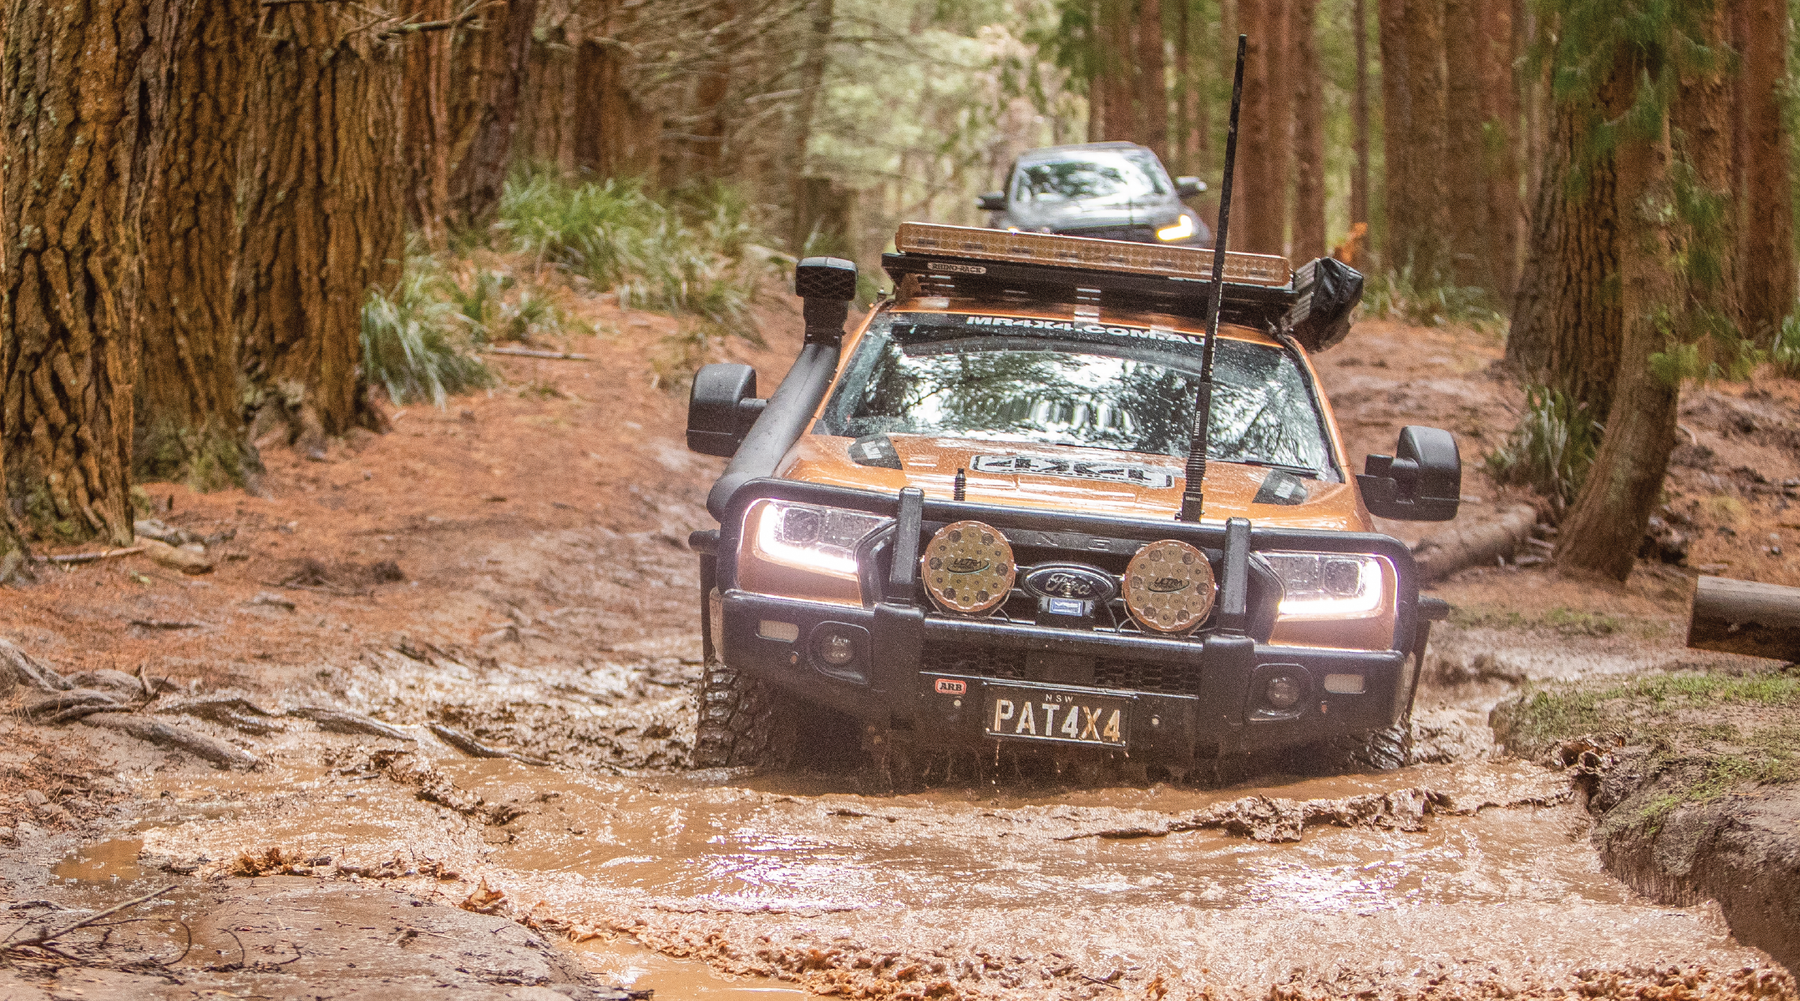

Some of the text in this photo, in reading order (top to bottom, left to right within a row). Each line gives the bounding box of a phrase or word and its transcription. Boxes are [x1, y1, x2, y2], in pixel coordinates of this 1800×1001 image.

[932, 263, 982, 273] RHINO-RACK
[966, 315, 1205, 346] MR4X4.COM.AU
[939, 682, 963, 692] ARB
[1045, 693, 1074, 703] NSW
[993, 698, 1121, 742] PAT4X4
